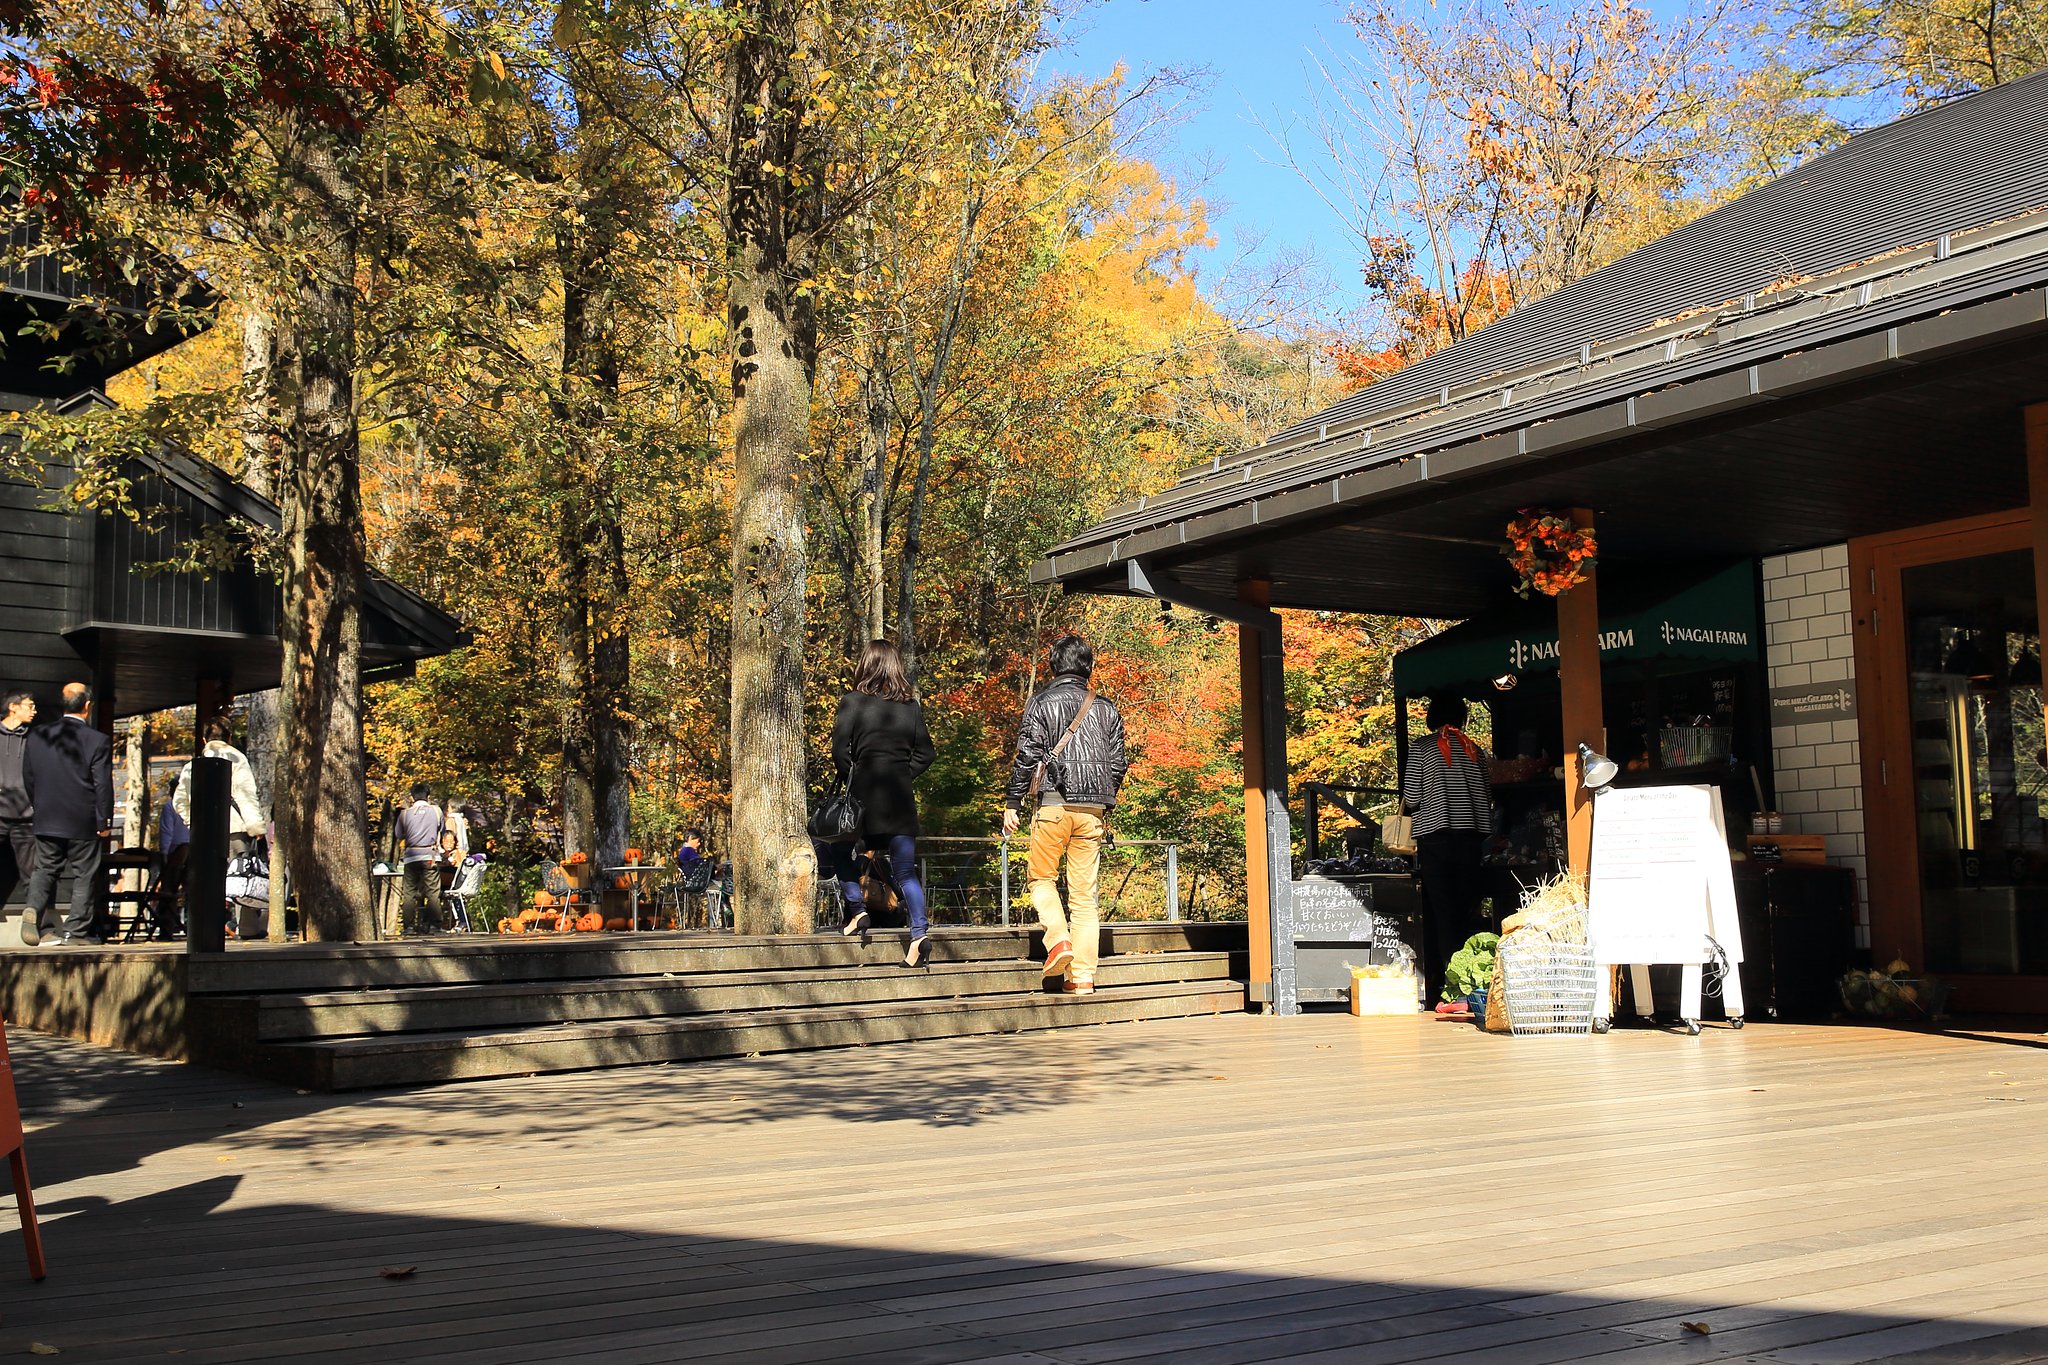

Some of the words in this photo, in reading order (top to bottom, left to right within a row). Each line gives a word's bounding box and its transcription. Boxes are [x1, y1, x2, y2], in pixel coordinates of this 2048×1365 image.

[1598, 629, 1634, 651] ARM
[1676, 627, 1714, 644] NAGAI
[1716, 629, 1747, 646] FARM
